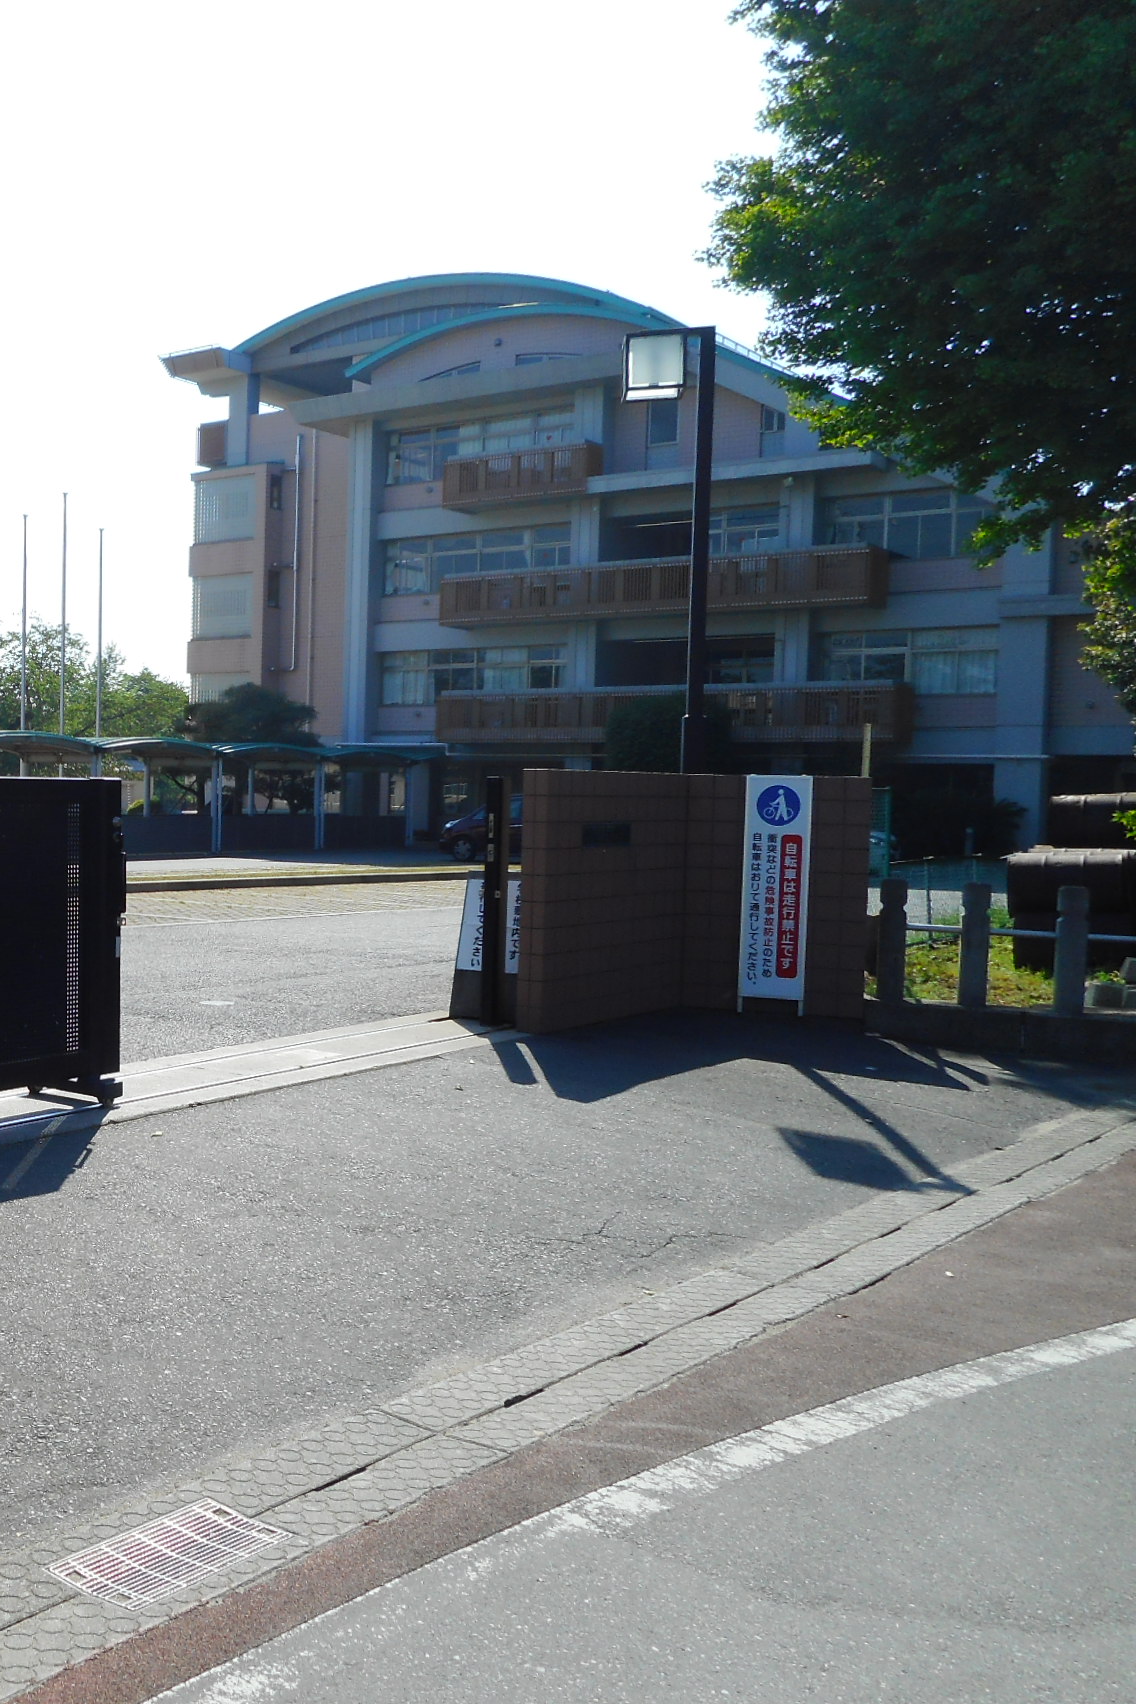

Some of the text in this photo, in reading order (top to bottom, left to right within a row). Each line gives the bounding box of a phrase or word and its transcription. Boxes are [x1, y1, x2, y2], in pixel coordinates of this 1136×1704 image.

[762, 833, 778, 978] 衝突などの危険事故防止のため
[781, 843, 797, 969] 自転車は走行禁止です
